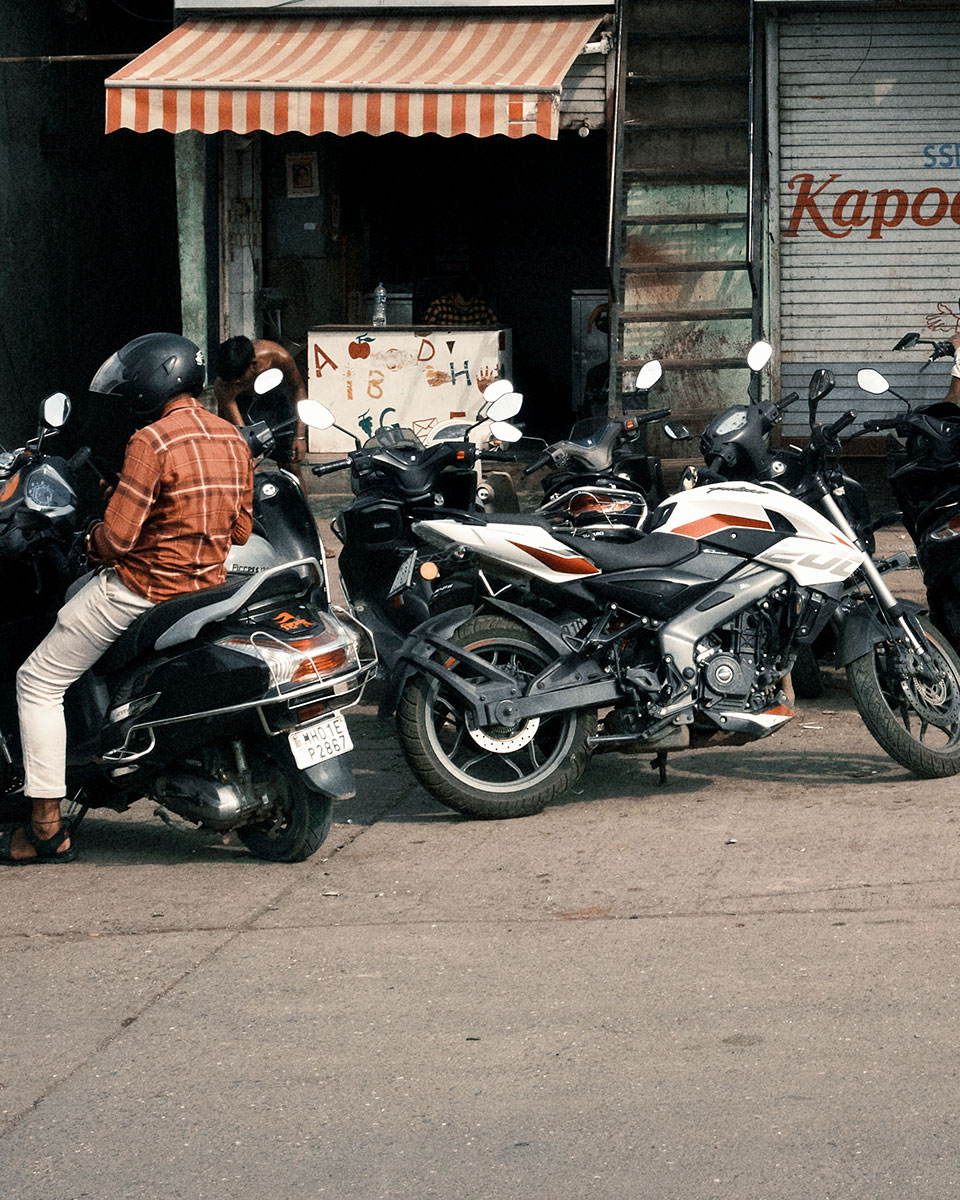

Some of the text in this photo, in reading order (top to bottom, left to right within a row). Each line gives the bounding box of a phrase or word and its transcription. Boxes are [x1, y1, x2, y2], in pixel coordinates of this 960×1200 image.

[314, 343, 338, 378] A
[417, 339, 436, 361] D
[449, 360, 472, 386] H
[307, 735, 346, 761] P2867
